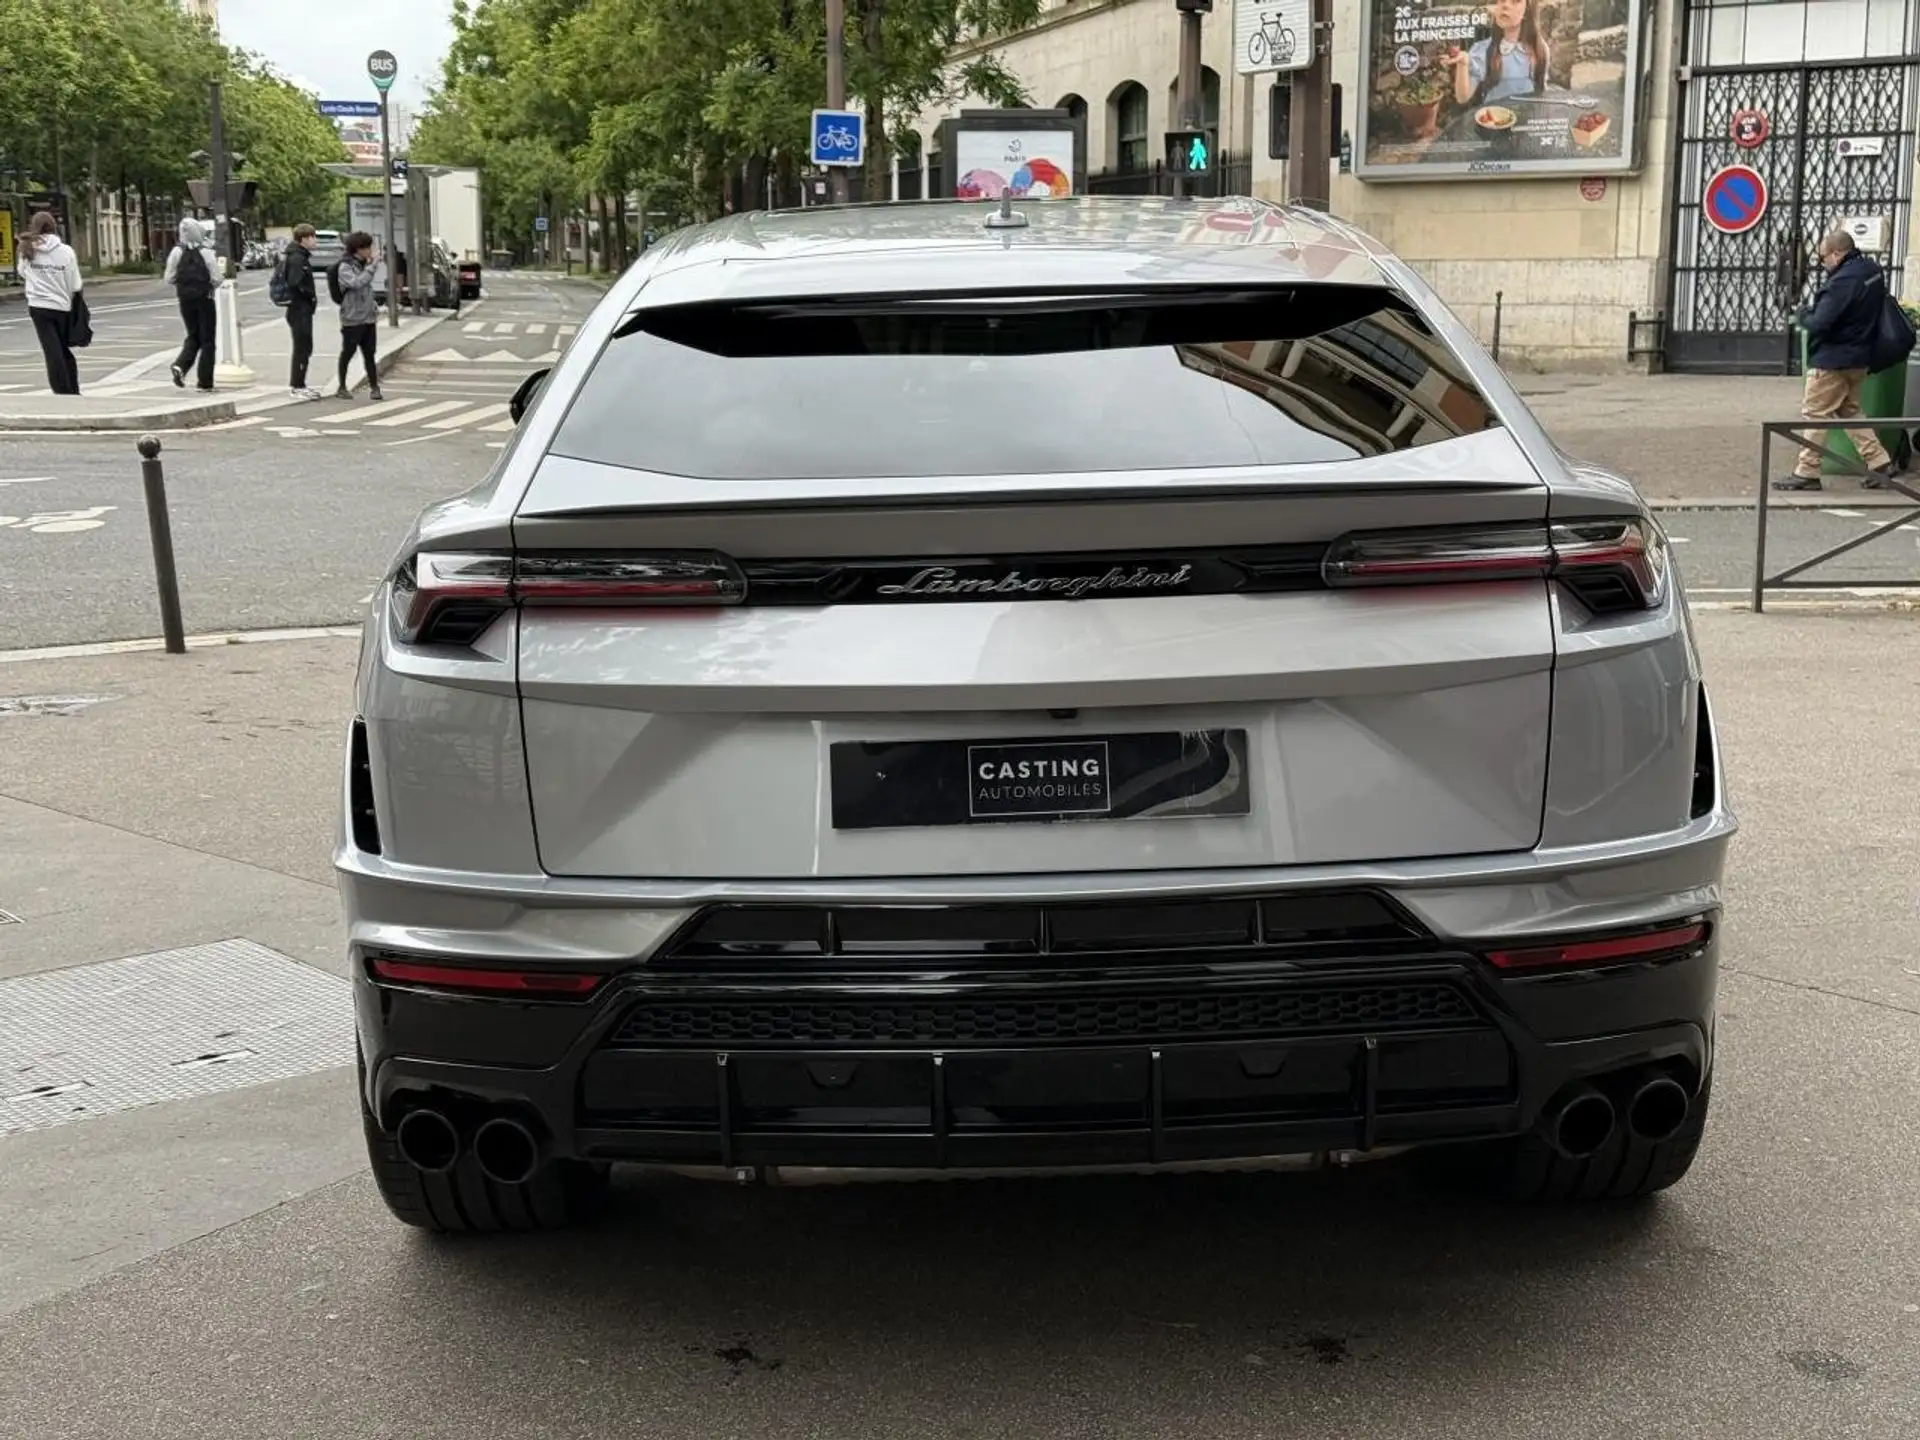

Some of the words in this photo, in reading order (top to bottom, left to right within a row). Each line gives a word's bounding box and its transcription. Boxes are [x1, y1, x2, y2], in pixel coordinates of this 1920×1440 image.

[1395, 18, 1419, 30] AUX
[1422, 14, 1469, 28] FRAISES
[1471, 13, 1488, 25] DE
[1394, 31, 1409, 43] LA
[1411, 26, 1475, 42] PRINCESSE
[370, 58, 393, 71] BUS
[876, 562, 1193, 597] Lamborghini
[979, 758, 1100, 780] CASTING
[979, 782, 1101, 800] AUTOMOBILES
